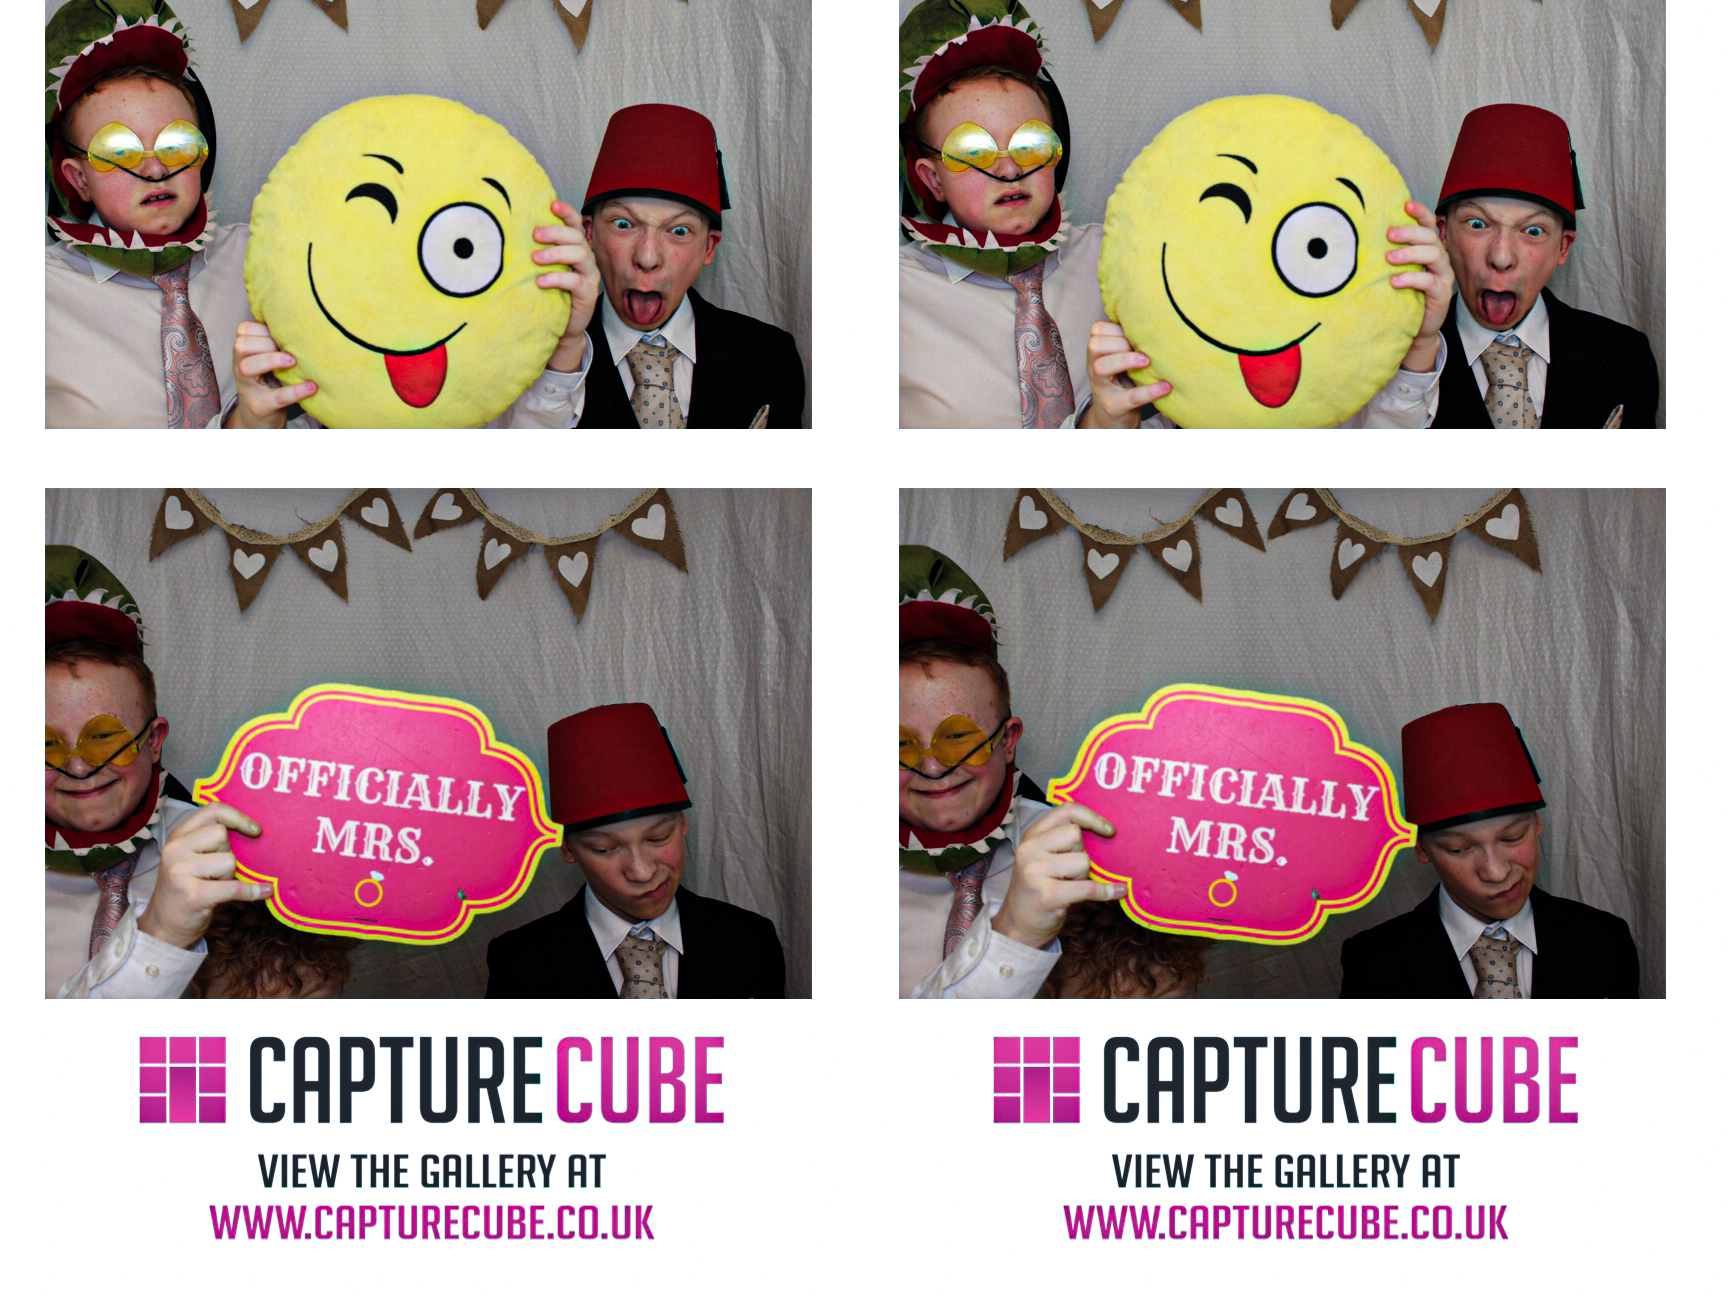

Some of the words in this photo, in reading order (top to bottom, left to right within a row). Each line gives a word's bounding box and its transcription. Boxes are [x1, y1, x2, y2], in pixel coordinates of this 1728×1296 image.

[240, 751, 526, 822] OFFICIALLY
[1094, 751, 1380, 822] OFFICIALLY
[311, 816, 434, 867] MRS.
[1165, 816, 1288, 867] MRS.
